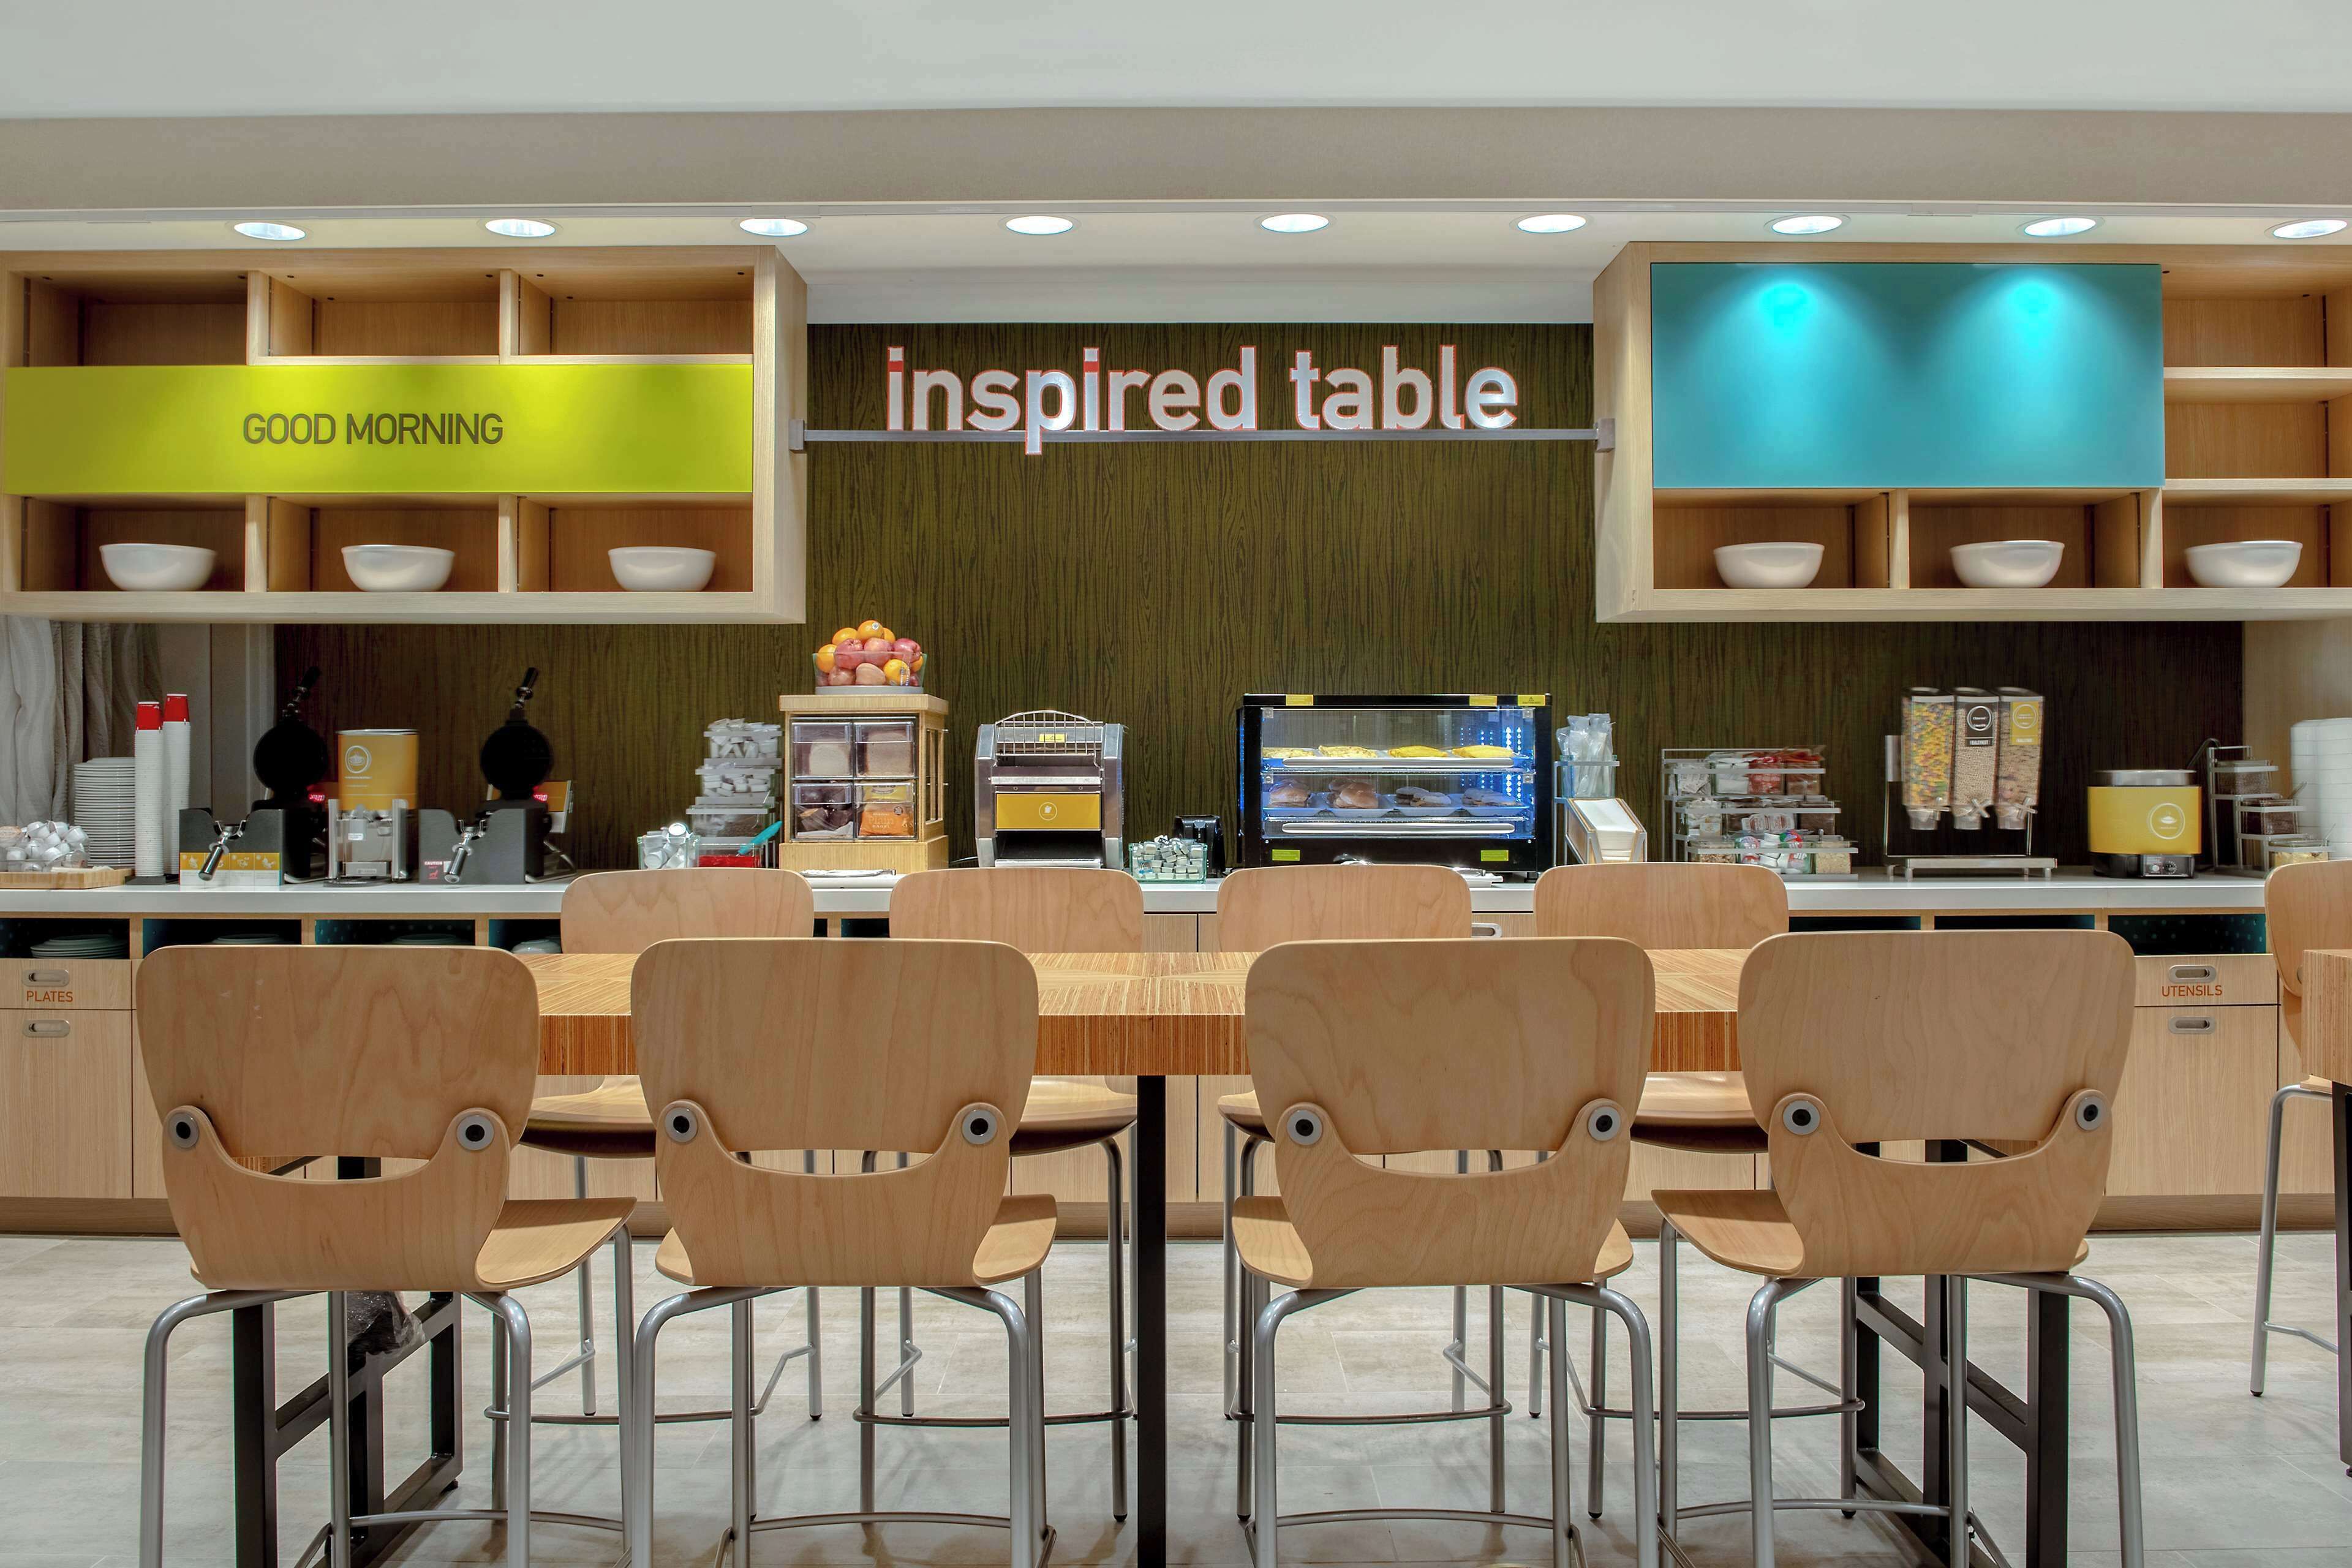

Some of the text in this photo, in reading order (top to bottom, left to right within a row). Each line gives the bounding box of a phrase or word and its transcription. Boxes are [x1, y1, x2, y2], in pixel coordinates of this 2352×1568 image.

[887, 344, 1518, 455] inspired table
[243, 413, 503, 445] GOOD MORNING
[26, 990, 74, 1002] PLATES
[2162, 985, 2223, 997] UTENSILS
